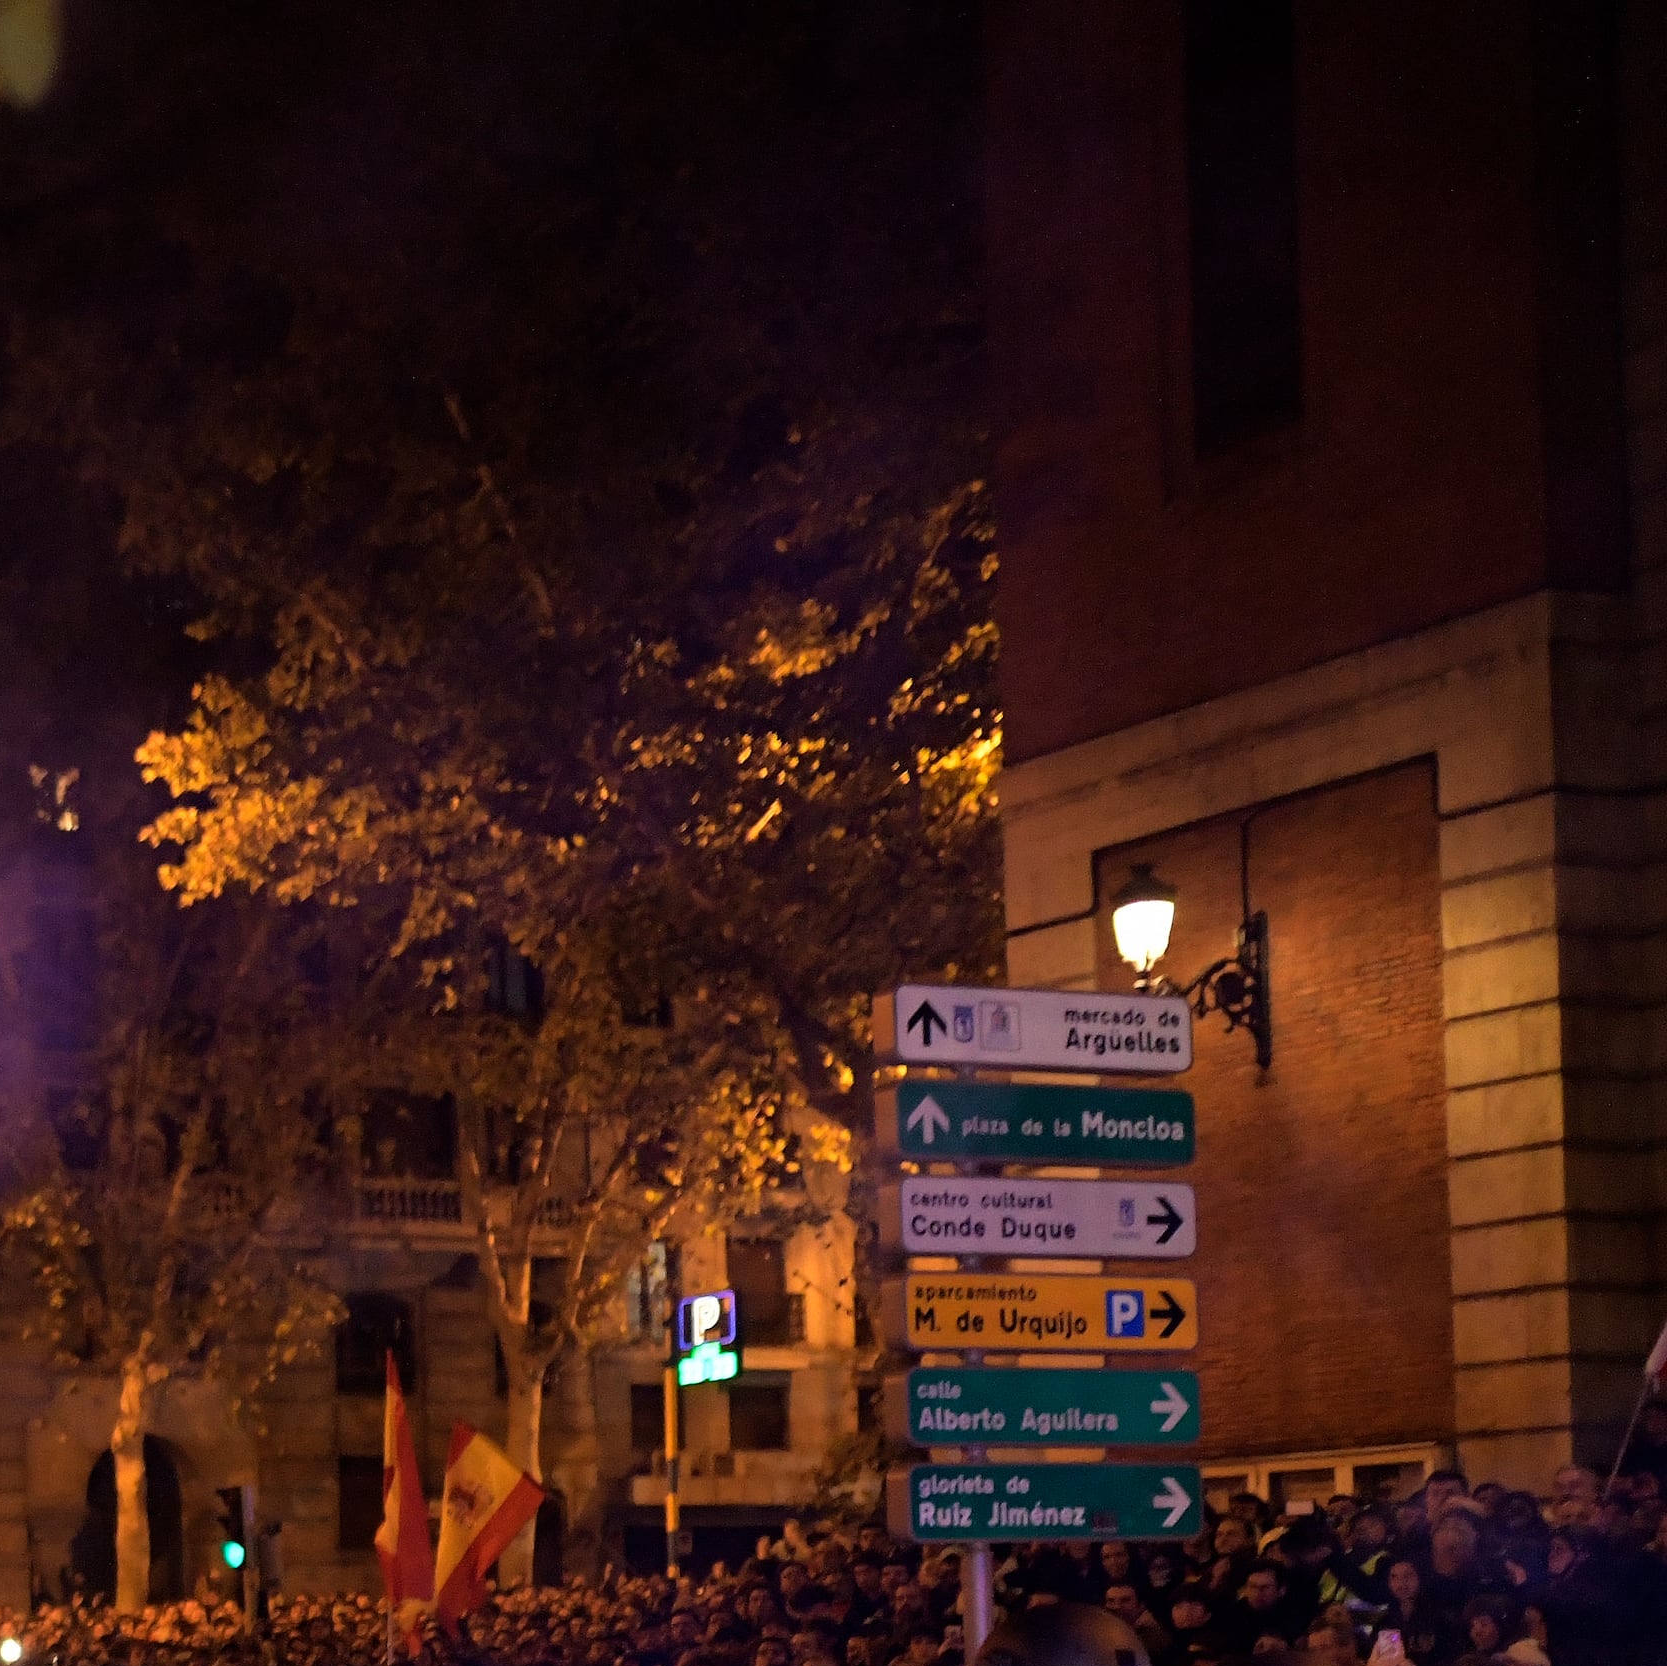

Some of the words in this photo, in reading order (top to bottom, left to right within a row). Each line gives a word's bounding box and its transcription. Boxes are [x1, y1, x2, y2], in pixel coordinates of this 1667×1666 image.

[1064, 1007, 1145, 1026] mercado
[1158, 1009, 1180, 1028] de
[962, 1116, 1009, 1136] plaza
[1021, 1117, 1043, 1136] de
[1054, 1117, 1071, 1137] la
[1081, 1109, 1185, 1141] Moncloa
[910, 1191, 969, 1207] centro
[981, 1191, 1053, 1210] cultural
[911, 1214, 985, 1238] Conde
[1001, 1217, 1076, 1243] Duque
[915, 1284, 1037, 1302] aparcamiento
[692, 1296, 720, 1346] P
[914, 1307, 941, 1332] M.
[956, 1310, 984, 1333] de
[999, 1308, 1088, 1341] Urquijo
[1111, 1294, 1139, 1335] P
[917, 1381, 962, 1399] calle
[919, 1406, 1006, 1431] Alberto
[1020, 1407, 1119, 1436] Aguilera
[919, 1474, 995, 1499] glorieta
[1006, 1475, 1030, 1494] de
[918, 1501, 973, 1527] Ruiz
[987, 1500, 1086, 1527] Jiménez
